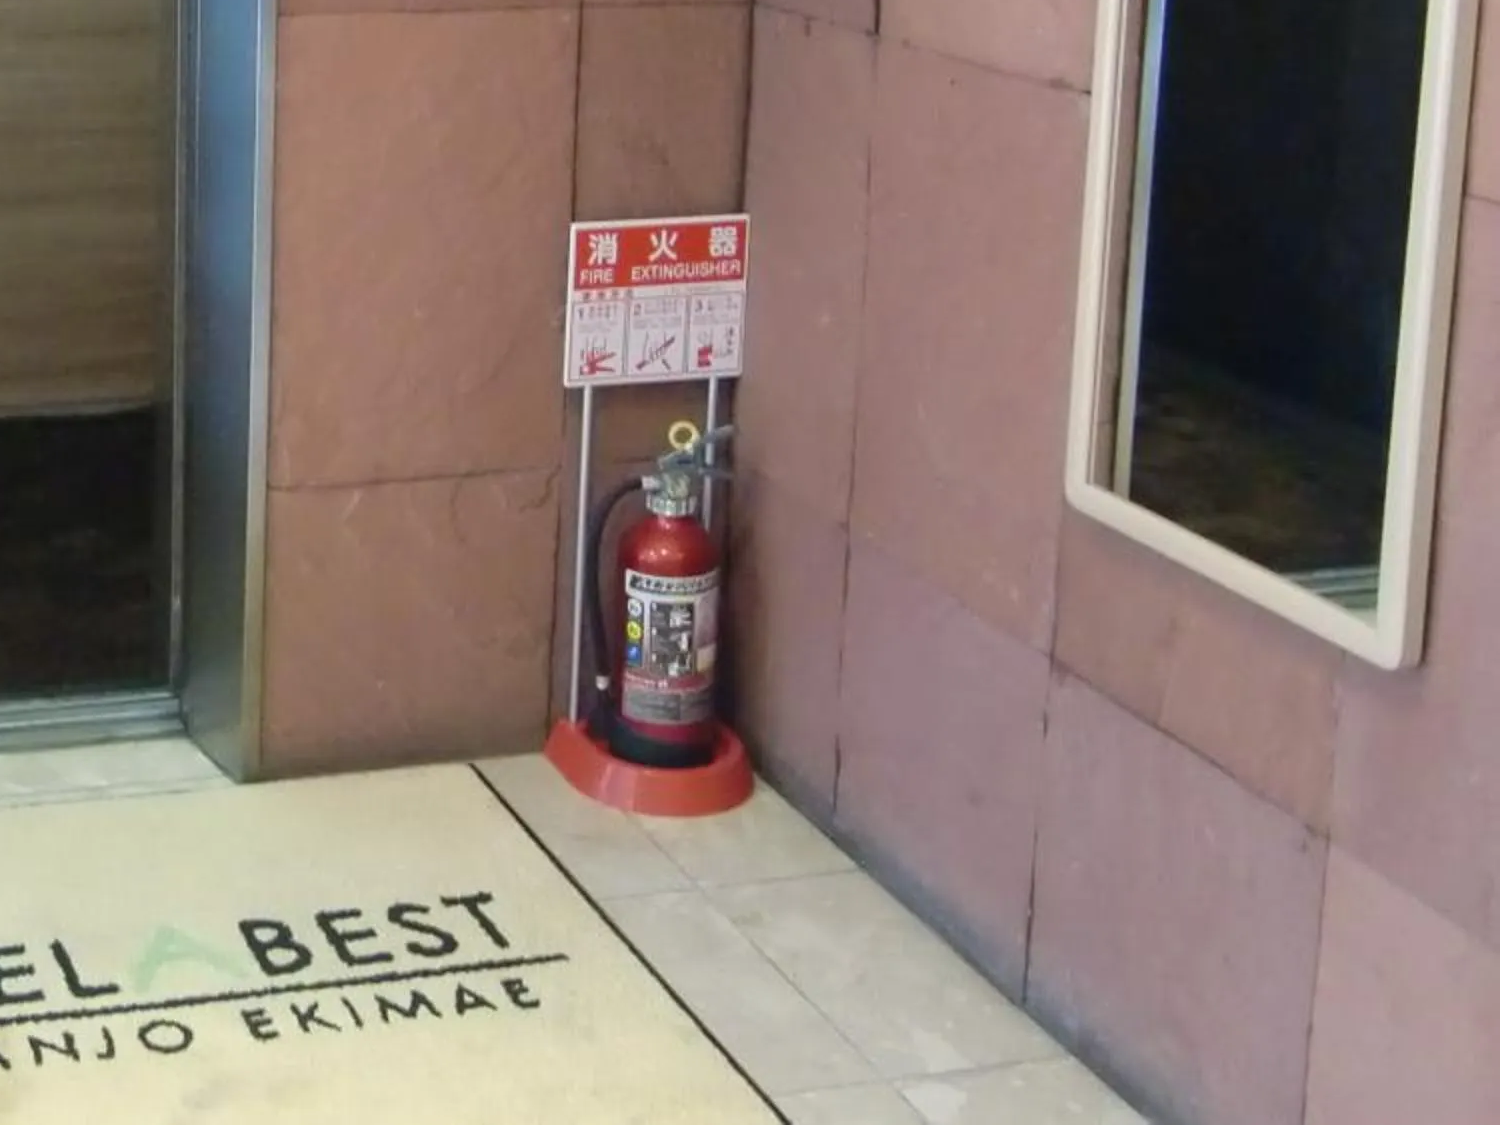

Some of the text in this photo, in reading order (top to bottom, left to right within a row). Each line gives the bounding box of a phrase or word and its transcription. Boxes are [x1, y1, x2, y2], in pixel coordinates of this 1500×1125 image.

[587, 226, 738, 265] 消火器
[579, 259, 741, 285] FIRE EXTINGUISHER
[239, 892, 510, 977] BEST
[241, 978, 541, 1042] EKIMAE
